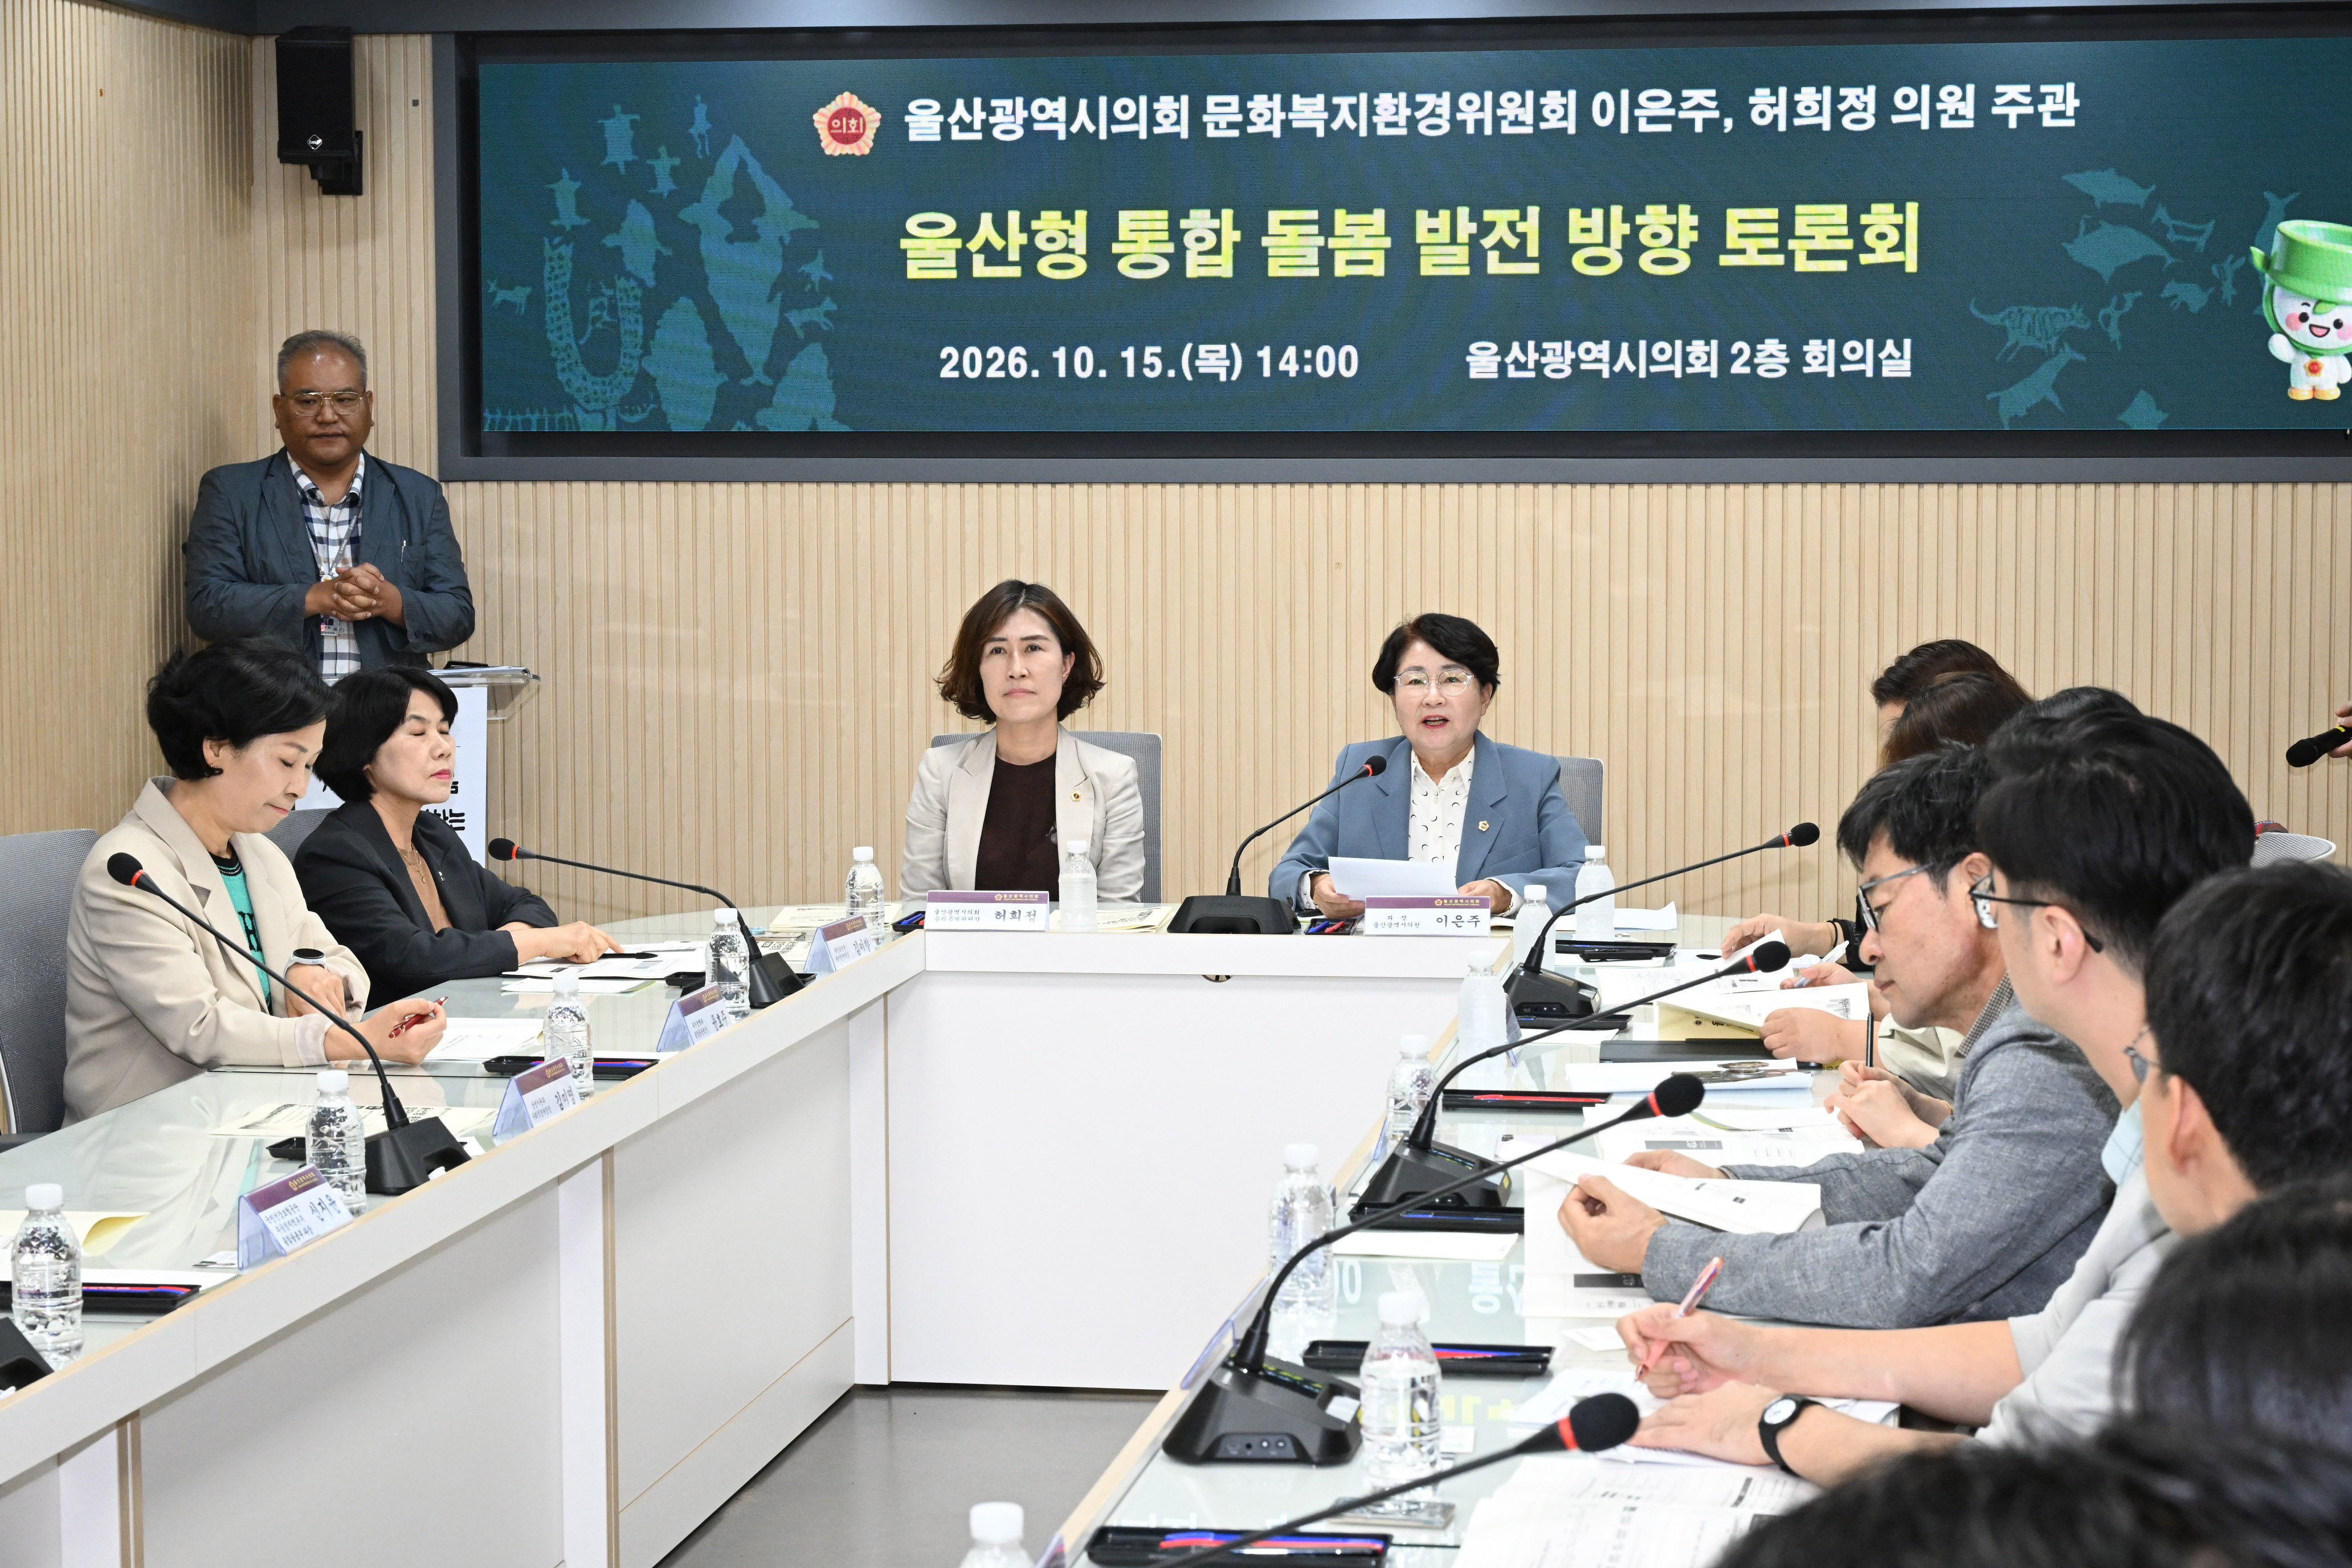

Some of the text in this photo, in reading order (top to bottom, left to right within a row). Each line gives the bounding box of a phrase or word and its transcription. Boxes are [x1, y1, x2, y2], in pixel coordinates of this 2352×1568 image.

[904, 81, 2081, 142] 울산광역시의회 문화복지환경위원회 이은주, 허희정 의원 주관
[830, 117, 864, 134] 의회
[899, 201, 1920, 280] 울산형 통합 돌봄 발전 방향 토론회
[940, 342, 1359, 382] 2026. 10. 15.(목) 14:00
[1465, 338, 1912, 380] 울산광역시의회 2층 회의실
[994, 909, 1037, 922] 허희정
[1436, 914, 1480, 928] 이은주
[853, 937, 871, 956] 김미향
[710, 1009, 728, 1032] 윤효주
[554, 1085, 576, 1110] 김미영
[309, 1194, 341, 1222] 신지윤
